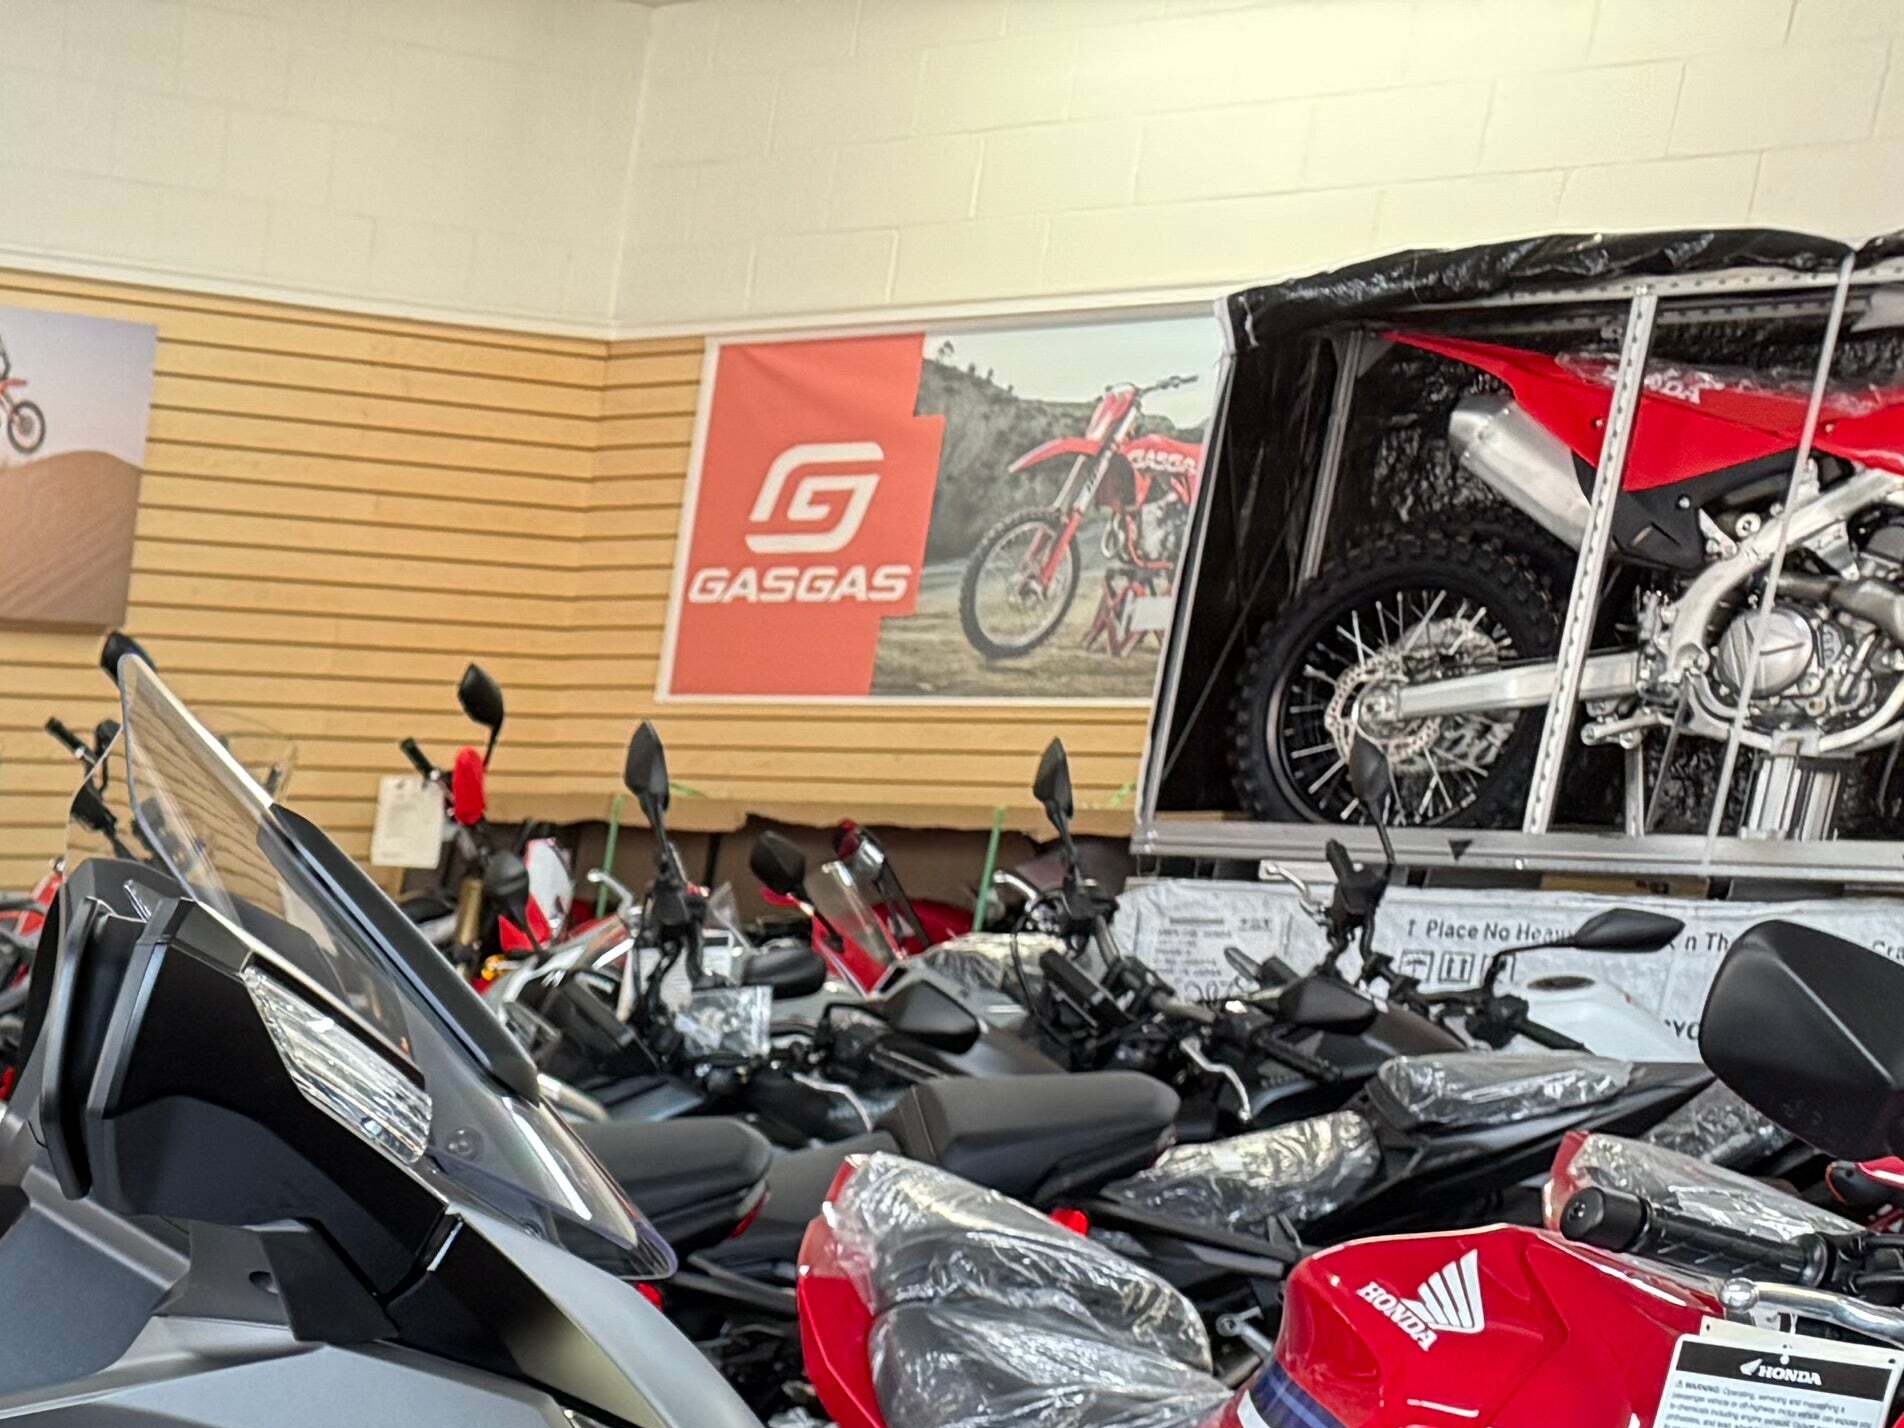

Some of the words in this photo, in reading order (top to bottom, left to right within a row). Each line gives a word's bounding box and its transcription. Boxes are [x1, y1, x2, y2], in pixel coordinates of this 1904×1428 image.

[1127, 449, 1198, 474] GASGA
[689, 565, 912, 603] GASGAS
[1426, 919, 1478, 940] Place
[1484, 922, 1510, 942] No
[1356, 1281, 1438, 1351] HONDA
[1757, 1364, 1822, 1386] HONDA
